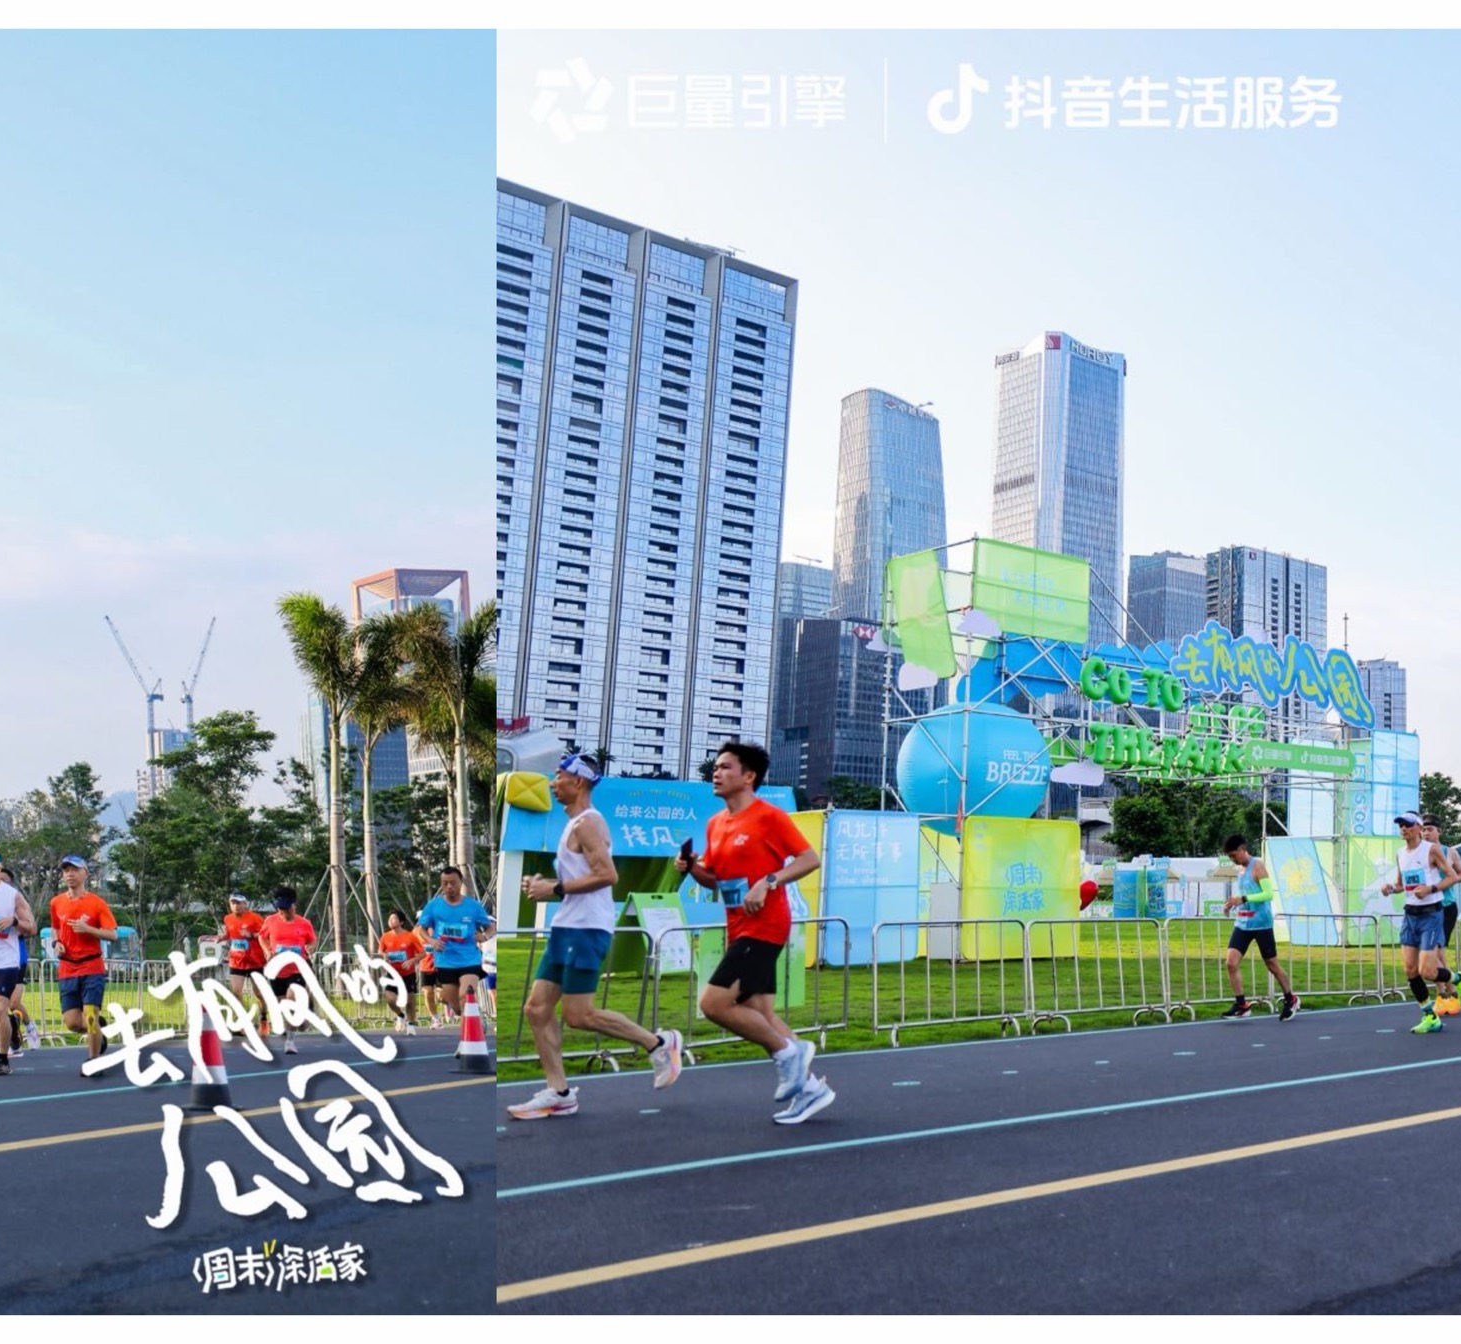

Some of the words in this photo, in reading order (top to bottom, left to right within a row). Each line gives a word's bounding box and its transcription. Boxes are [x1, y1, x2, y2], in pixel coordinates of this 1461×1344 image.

[1080, 656, 1133, 705] GO
[1142, 667, 1184, 712] TO
[1090, 723, 1161, 767] THE
[1160, 734, 1246, 775] PARK
[615, 804, 698, 821] 给来公园的人
